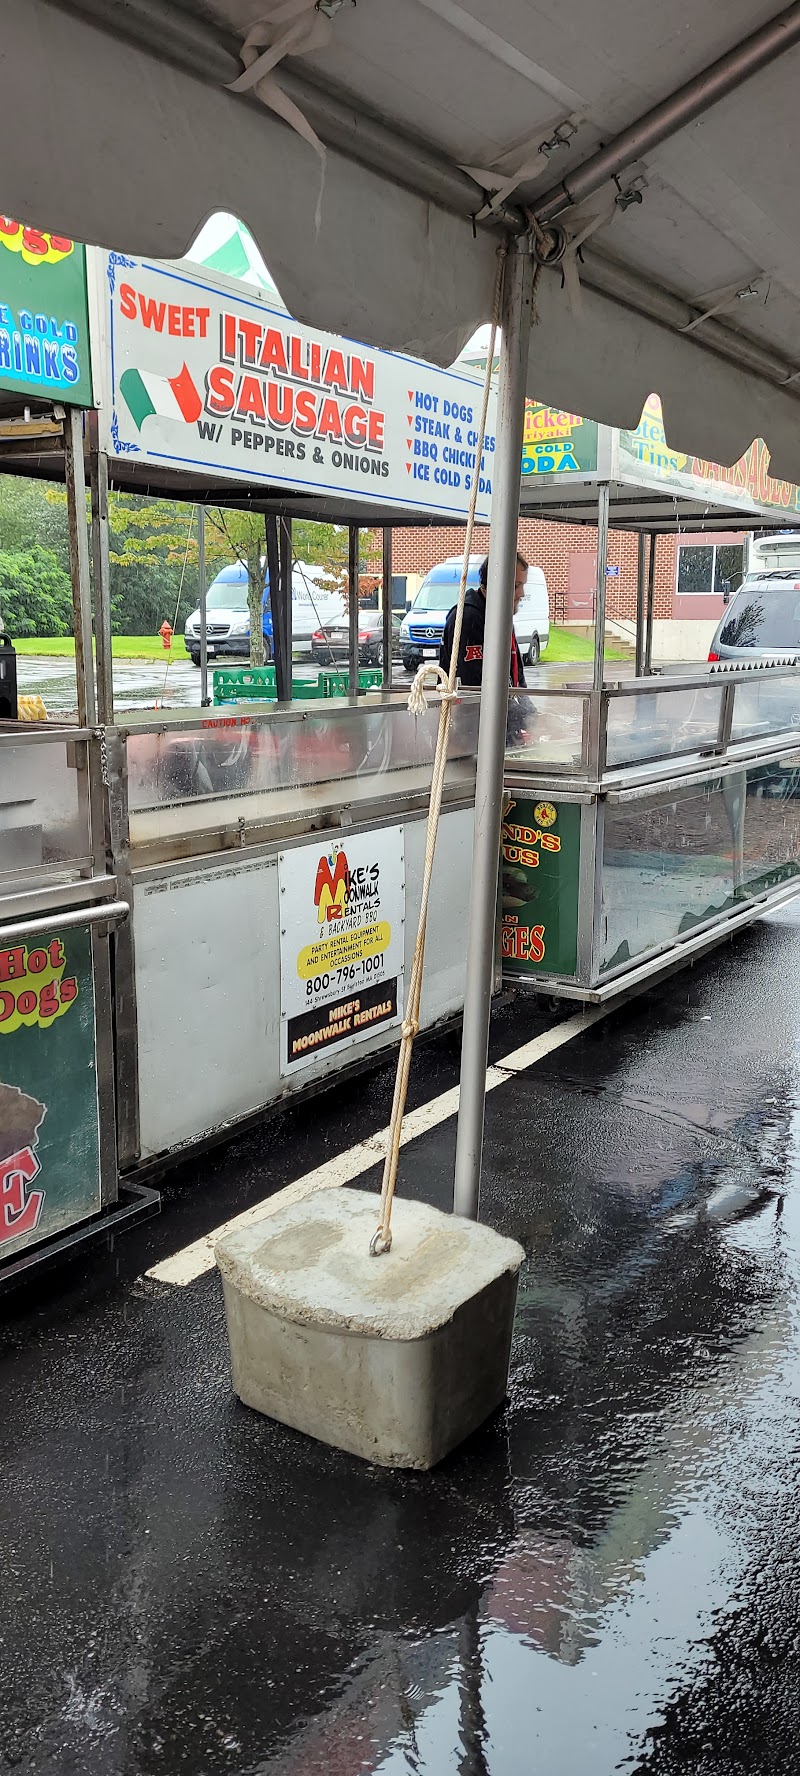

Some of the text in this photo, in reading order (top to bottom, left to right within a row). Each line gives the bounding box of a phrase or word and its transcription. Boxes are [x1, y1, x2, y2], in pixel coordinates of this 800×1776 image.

[20, 311, 77, 342] COLD
[119, 283, 210, 338] SWEET
[220, 311, 375, 404] ITALIAN
[204, 364, 385, 454] SAUSAGE
[415, 391, 473, 423] HOT DOGS
[198, 420, 389, 478] W/ PEPPERS & ONIONS
[415, 415, 495, 452] STEAK & CHES
[535, 443, 572, 454] COLD
[414, 439, 438, 462] BBQ
[634, 440, 679, 476] Tips
[413, 463, 492, 495] ICE COLD SDA
[202, 716, 256, 729] CAUTION HO
[327, 897, 380, 922] RENTALS
[329, 914, 361, 936] BACKYARD
[365, 910, 378, 924] BBQ
[306, 934, 384, 966] AND ENTERTAINMENT FOR ALL
[311, 925, 379, 955] PARTY RENTAL EQUIPMENT
[0, 939, 66, 982] Hot
[306, 953, 384, 995] 800-796-1001
[330, 950, 363, 967] OCCASSIONS
[292, 1000, 392, 1053] MOONWALK RENTALS
[329, 999, 361, 1022] MIKE'S
